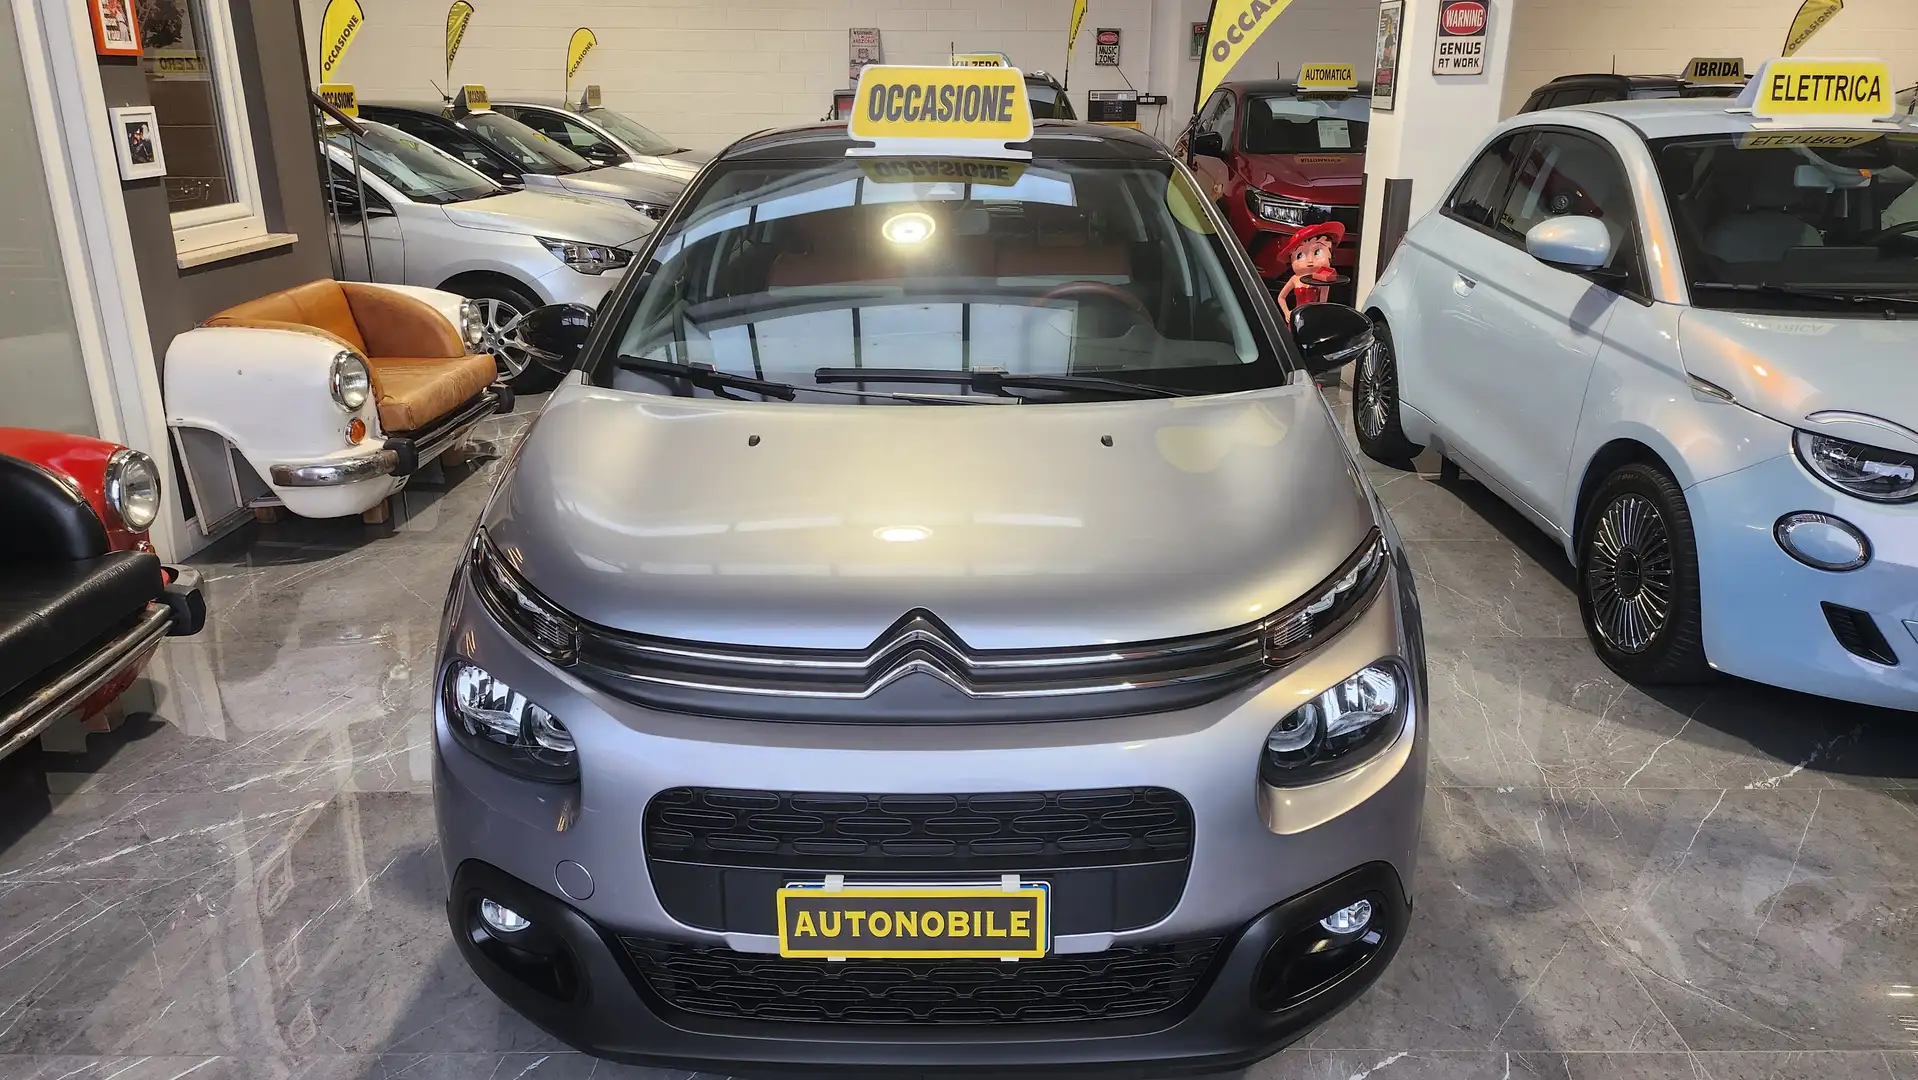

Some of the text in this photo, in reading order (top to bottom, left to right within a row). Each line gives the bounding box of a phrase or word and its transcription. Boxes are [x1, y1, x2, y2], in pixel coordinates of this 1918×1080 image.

[1446, 9, 1484, 27] WARNING
[1789, 4, 1838, 50] OCCASIONE
[324, 15, 359, 71] OCCASIONE
[449, 12, 472, 61] OCCASIONE
[569, 41, 593, 78] OCCASIONE
[1099, 46, 1117, 55] MUSIC
[1099, 55, 1115, 63] ZONE
[1440, 42, 1482, 55] GENIUS
[1438, 58, 1480, 68] AT WORK
[1694, 62, 1740, 77] IBRIDA
[1305, 69, 1352, 81] AUTOMATICA
[1771, 75, 1881, 102] ELETTRICA
[868, 84, 1016, 122] OCCASIONE
[794, 910, 1030, 938] AUTONOBILE
